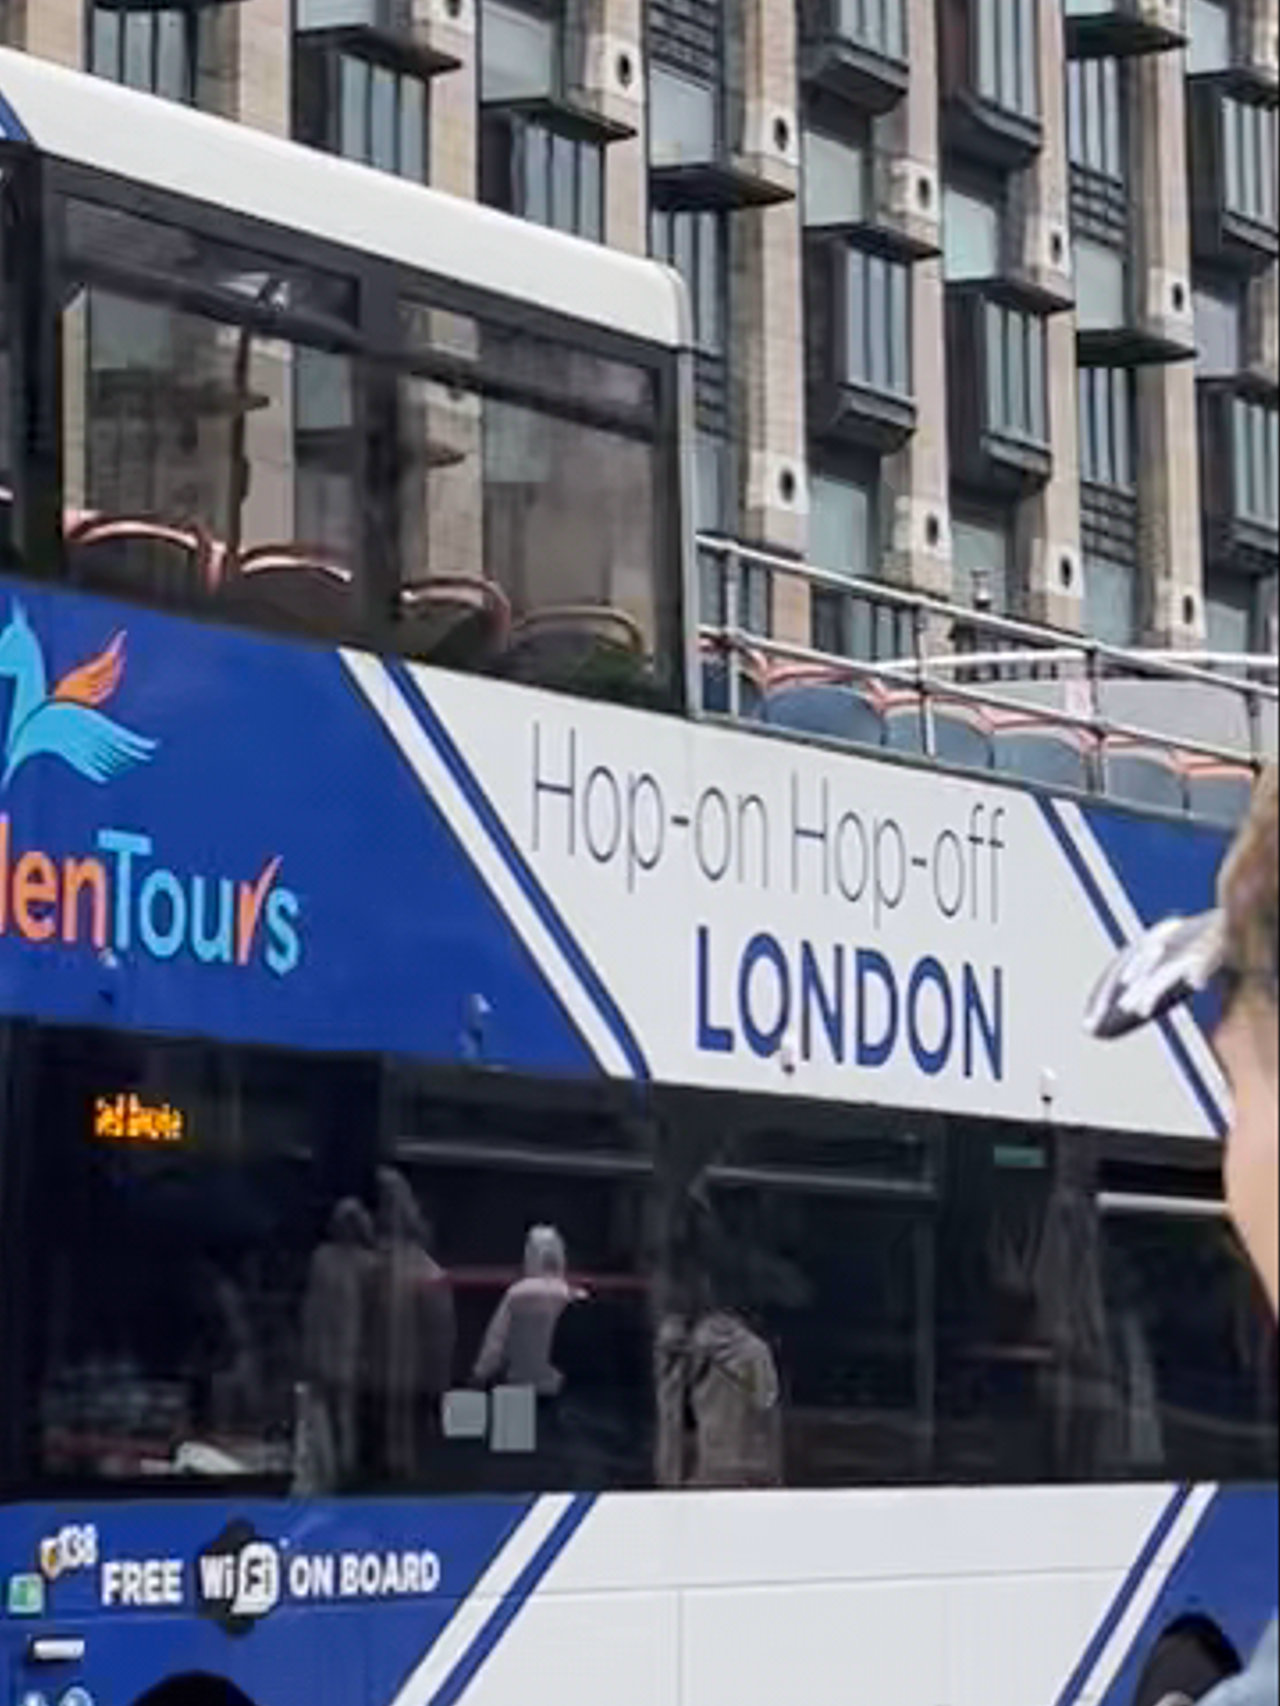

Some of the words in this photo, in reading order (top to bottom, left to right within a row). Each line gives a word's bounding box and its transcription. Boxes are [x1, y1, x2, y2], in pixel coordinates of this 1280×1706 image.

[532, 722, 768, 893] Hop-on
[791, 769, 1005, 929] Hop-off
[697, 924, 1002, 1082] LONDON
[101, 1559, 184, 1606] FREE
[289, 1554, 333, 1597] ON
[339, 1549, 440, 1596] BOARD
